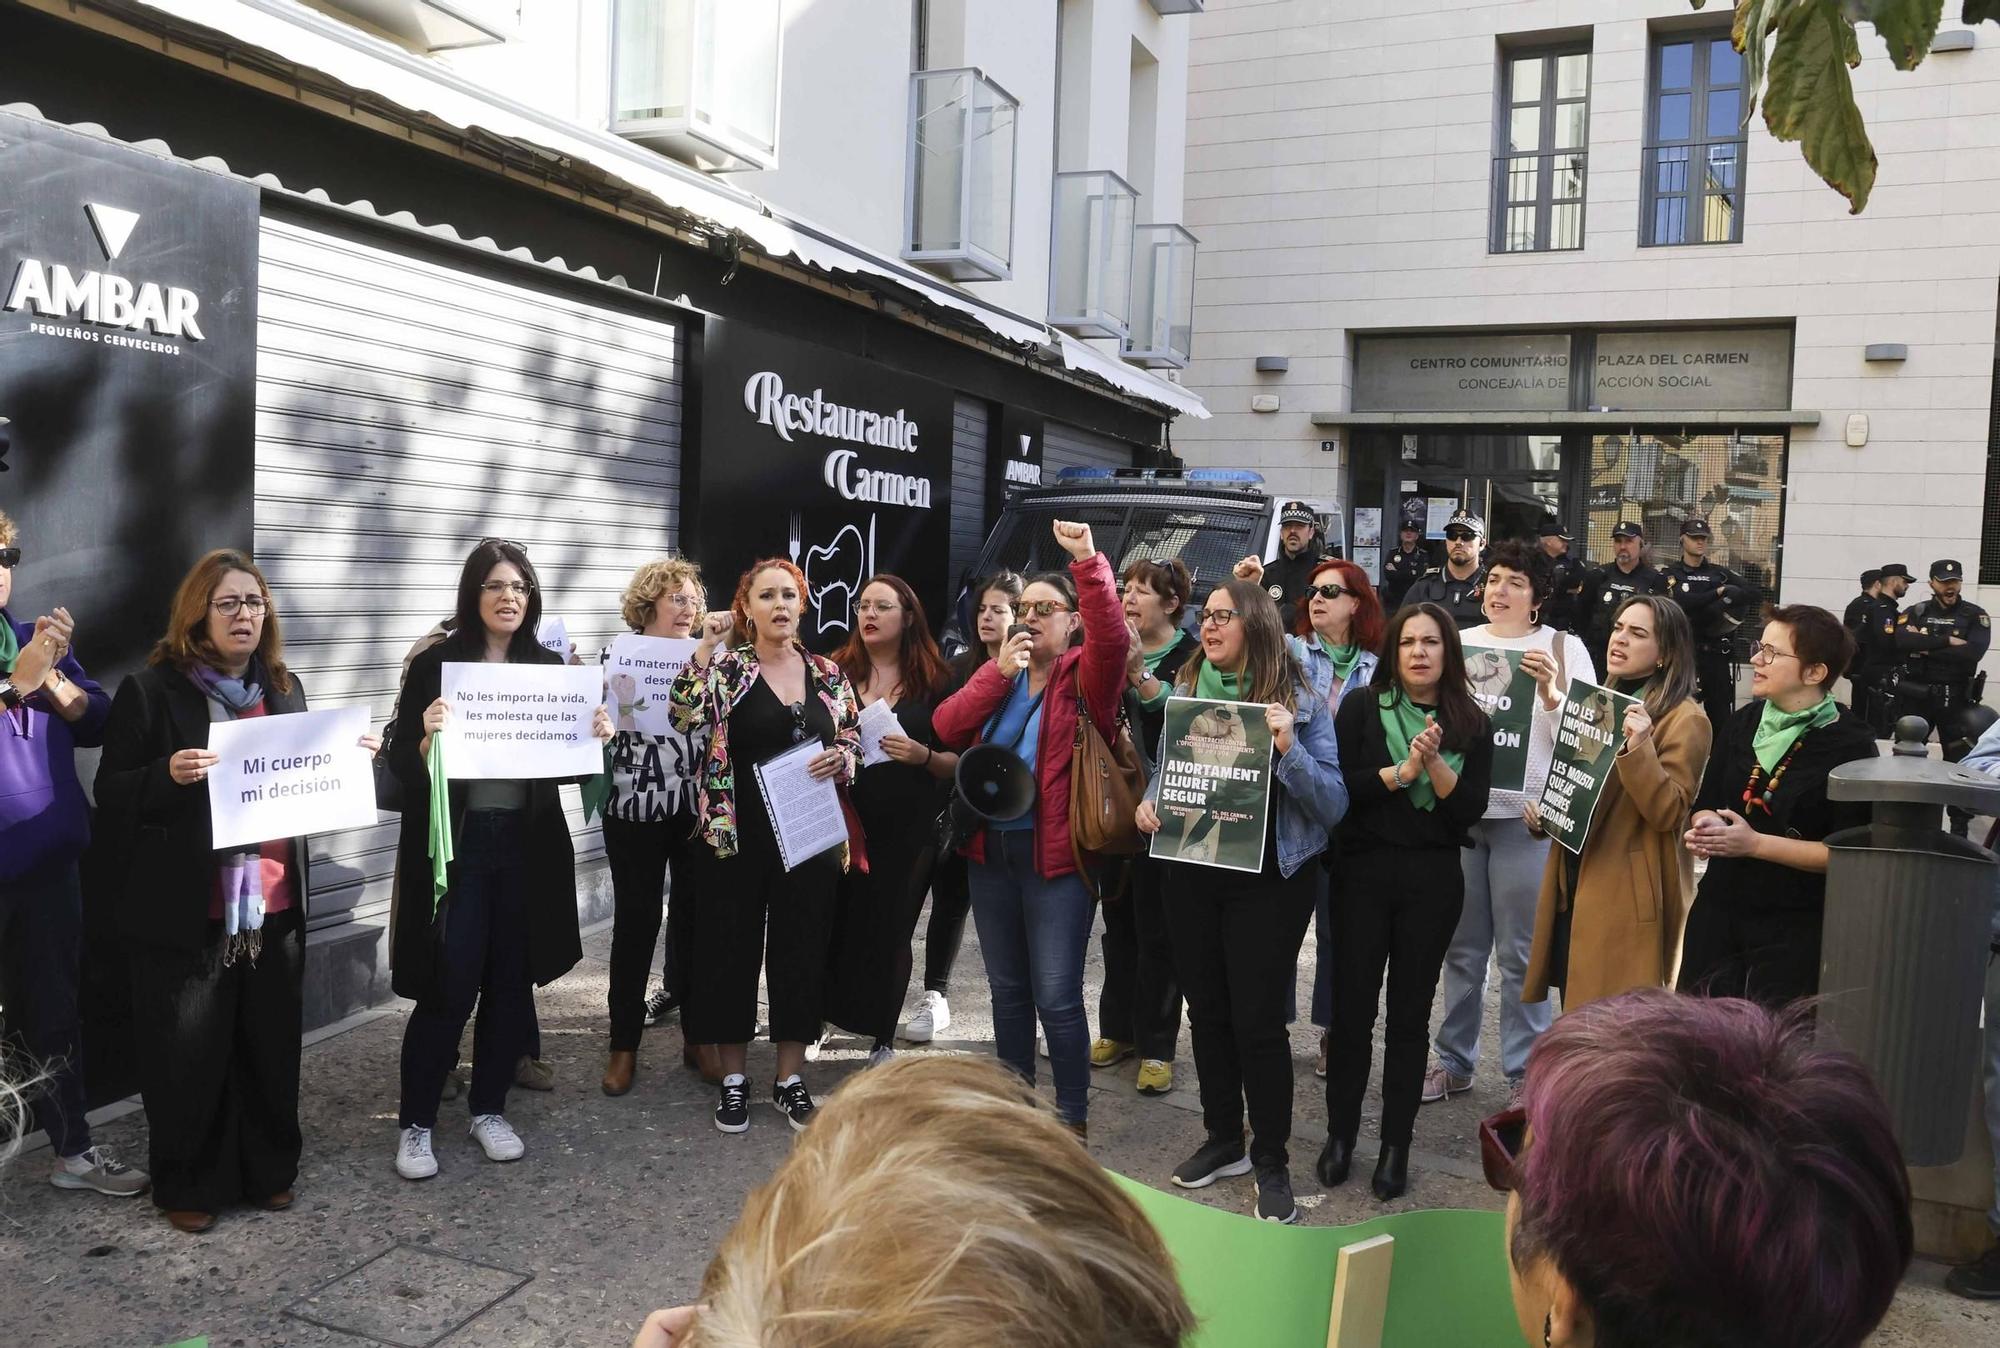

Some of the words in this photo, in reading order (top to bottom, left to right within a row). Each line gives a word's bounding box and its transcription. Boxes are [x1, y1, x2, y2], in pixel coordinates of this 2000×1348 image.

[3, 258, 205, 342] AMBAR
[30, 323, 99, 342] PEQUEÑOS
[103, 334, 180, 355] CERVECEROS
[1410, 358, 1466, 369] CENTRO
[1470, 354, 1568, 368] COMUNITARIO
[1597, 354, 1645, 366] PLAZA
[1649, 354, 1679, 366] DEL
[1682, 352, 1749, 365] CARMEN
[1458, 375, 1543, 389] CONCEJALÍA
[1547, 376, 1567, 388] DE
[1597, 375, 1651, 388] ACCIÓN
[1657, 375, 1712, 387] SOCIAL
[743, 371, 919, 453] Restaurante
[1325, 442, 1331, 450] 9
[823, 449, 931, 509] Carmen
[1005, 459, 1041, 486] AMBAR
[618, 656, 632, 667] La
[644, 675, 674, 686] dese
[457, 691, 474, 702] No
[477, 691, 494, 702] les
[497, 692, 544, 705] importa
[547, 693, 558, 703] la
[560, 694, 588, 705] vida,
[652, 693, 668, 701] no
[466, 711, 483, 722] les
[485, 711, 533, 722] molesta
[536, 711, 559, 724] que
[561, 711, 577, 722] las
[1566, 700, 1580, 716] NO
[1581, 706, 1596, 723] LES
[464, 731, 512, 743] mujeres
[515, 730, 578, 742] decidamos
[1560, 730, 1583, 752] VIDA,
[1562, 715, 1602, 742] IMPORTA
[1602, 731, 1614, 747] LA
[243, 757, 266, 775] Mi
[271, 753, 332, 771] cuerpo
[1166, 759, 1261, 782] AVORTAMENT
[1552, 758, 1567, 776] LES
[1567, 765, 1596, 790] MOLESTA
[241, 786, 263, 803] mi
[269, 776, 341, 799] decisión
[1164, 774, 1210, 791] LLIURE
[1212, 780, 1217, 792] I
[1548, 774, 1564, 790] QUE
[1562, 780, 1577, 797] LAS
[1162, 788, 1207, 806] SEGUR
